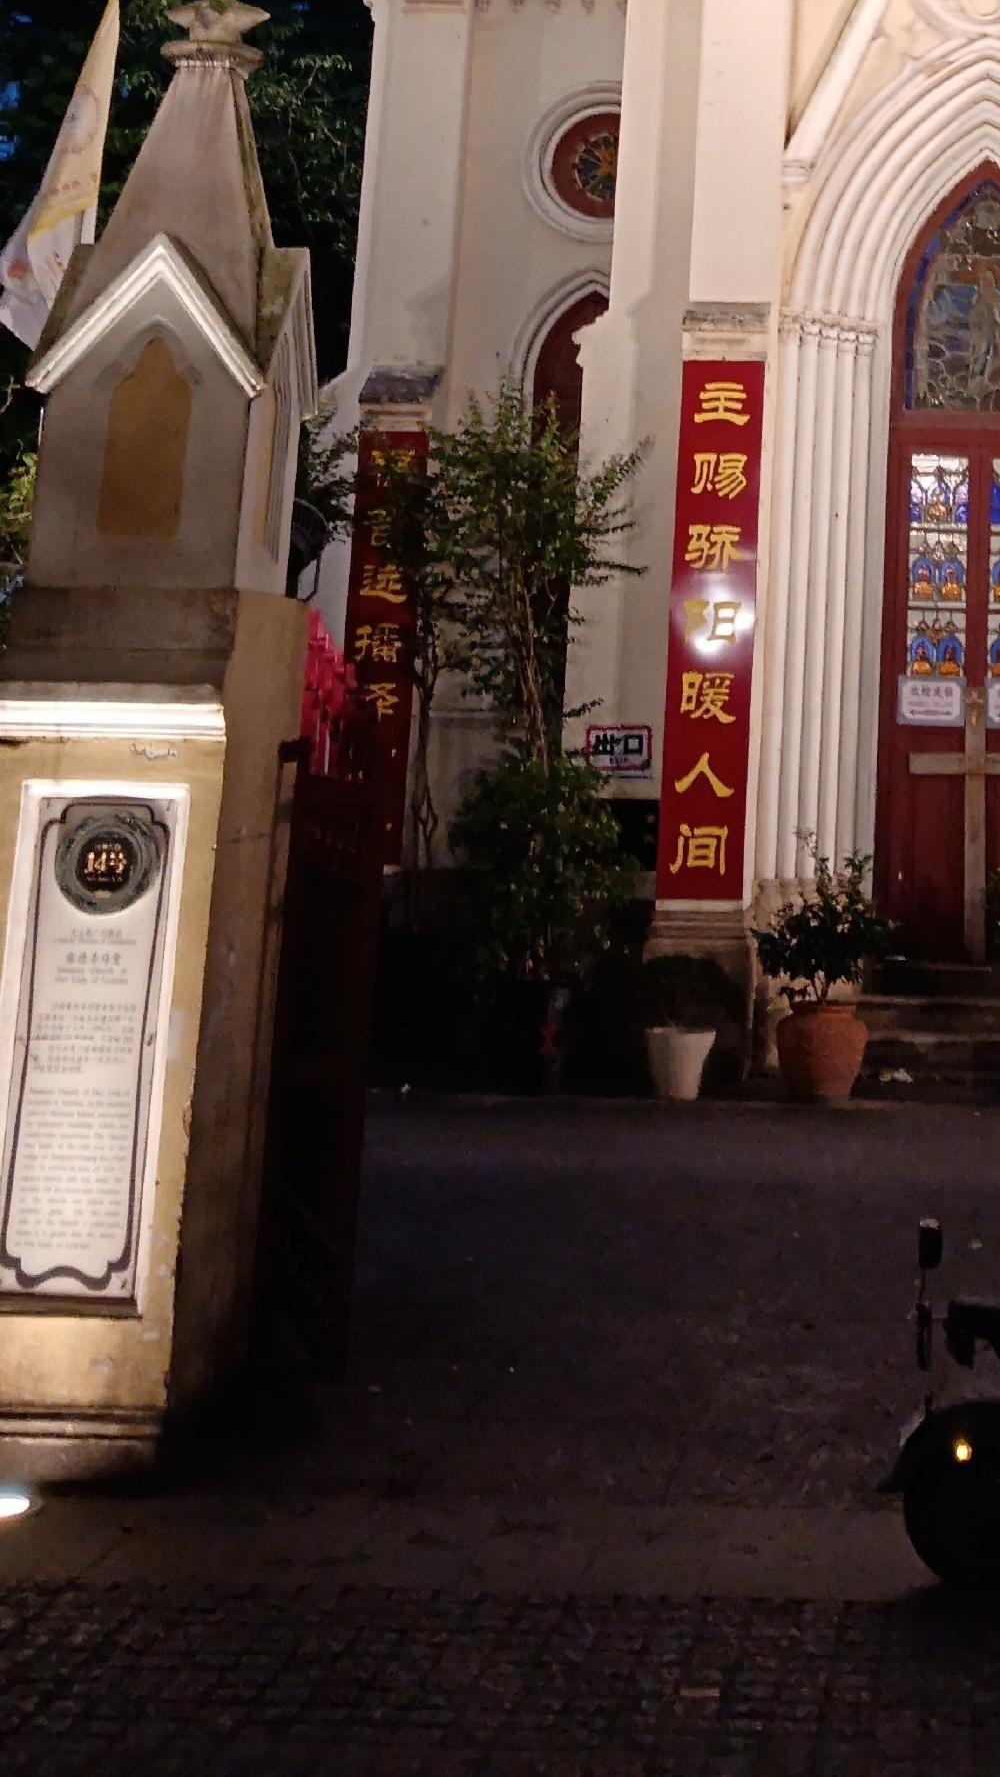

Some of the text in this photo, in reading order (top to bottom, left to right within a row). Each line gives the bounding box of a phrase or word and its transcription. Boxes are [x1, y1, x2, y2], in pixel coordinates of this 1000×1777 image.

[591, 733, 644, 756] 出口
[669, 381, 751, 876] 主赐骄阳暖人间
